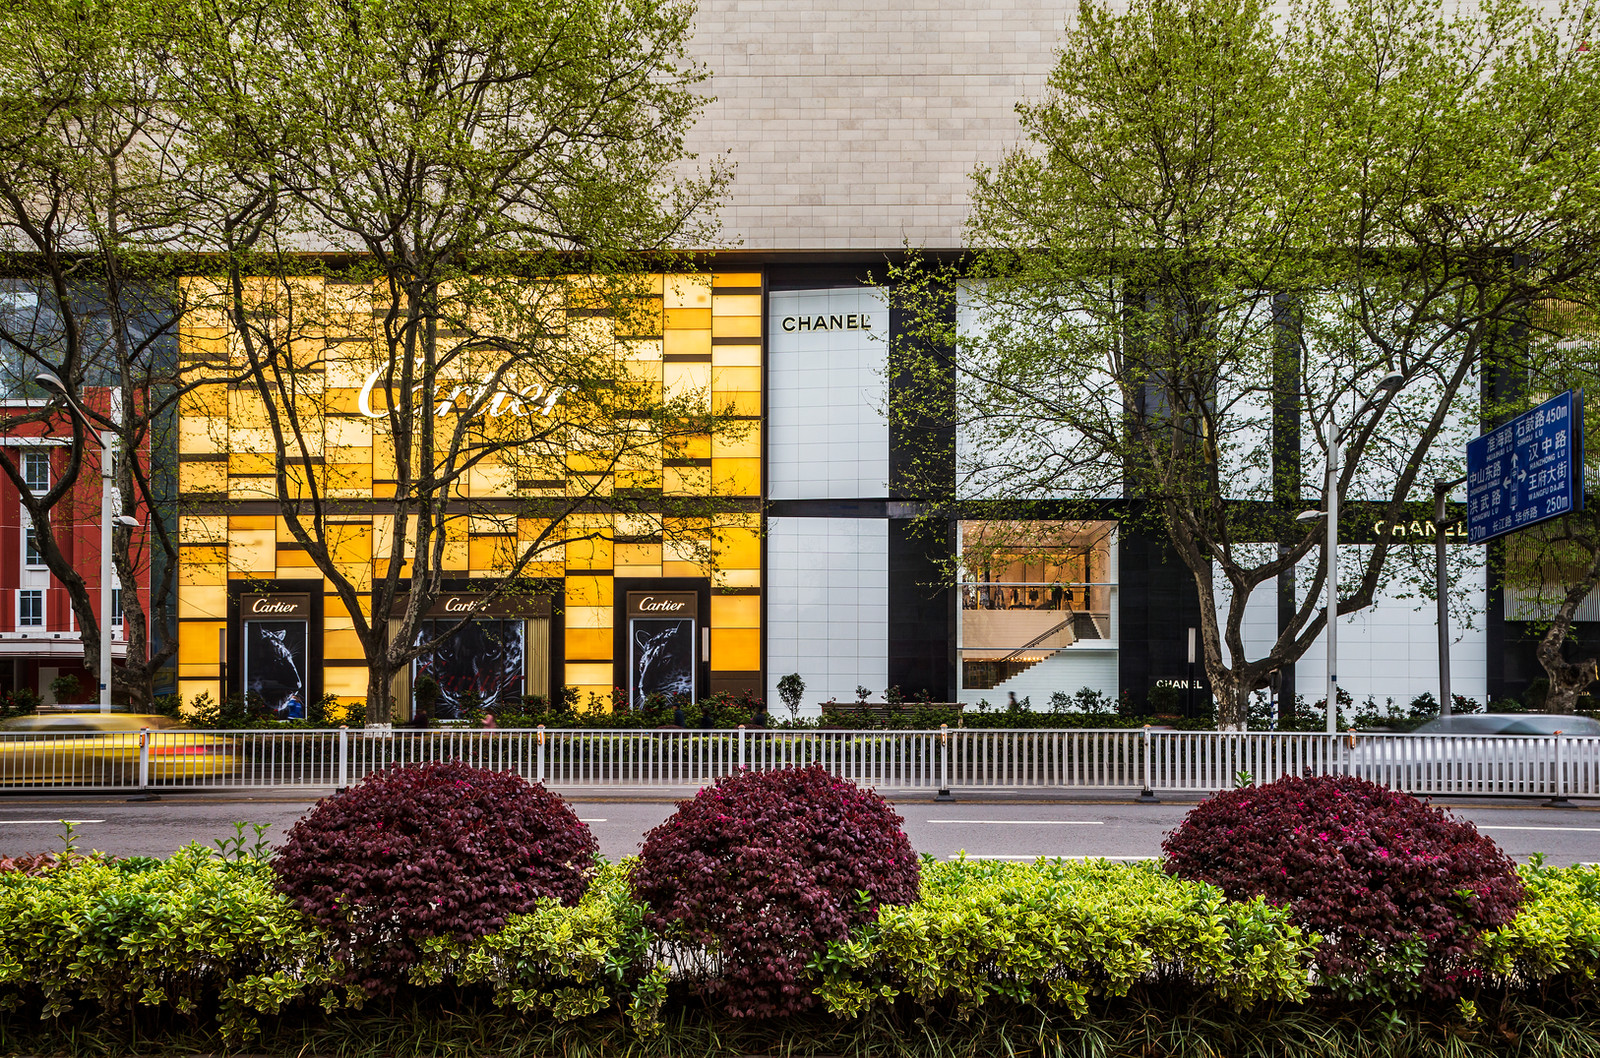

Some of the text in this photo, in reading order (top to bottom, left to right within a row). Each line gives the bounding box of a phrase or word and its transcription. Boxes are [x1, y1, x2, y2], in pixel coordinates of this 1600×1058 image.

[782, 314, 872, 332] CHANEL
[1516, 405, 1567, 437] 石鼓路 450m
[1535, 429, 1543, 439] LU
[1506, 443, 1513, 453] LU
[1529, 430, 1567, 461] 汉中路
[1557, 449, 1566, 459] LU
[1469, 461, 1501, 487] 中山东路
[1528, 461, 1567, 491] 王府大街
[1528, 480, 1565, 501] WANGFU DAJIE
[1469, 489, 1501, 515] 洪武路
[1470, 525, 1486, 541] 370m
[1492, 515, 1512, 532] 长江路
[1546, 495, 1568, 513] 250m
[1491, 507, 1499, 516] LU
[252, 598, 298, 613] Cartier
[445, 597, 491, 611] Cartir
[639, 596, 686, 611] Cartier
